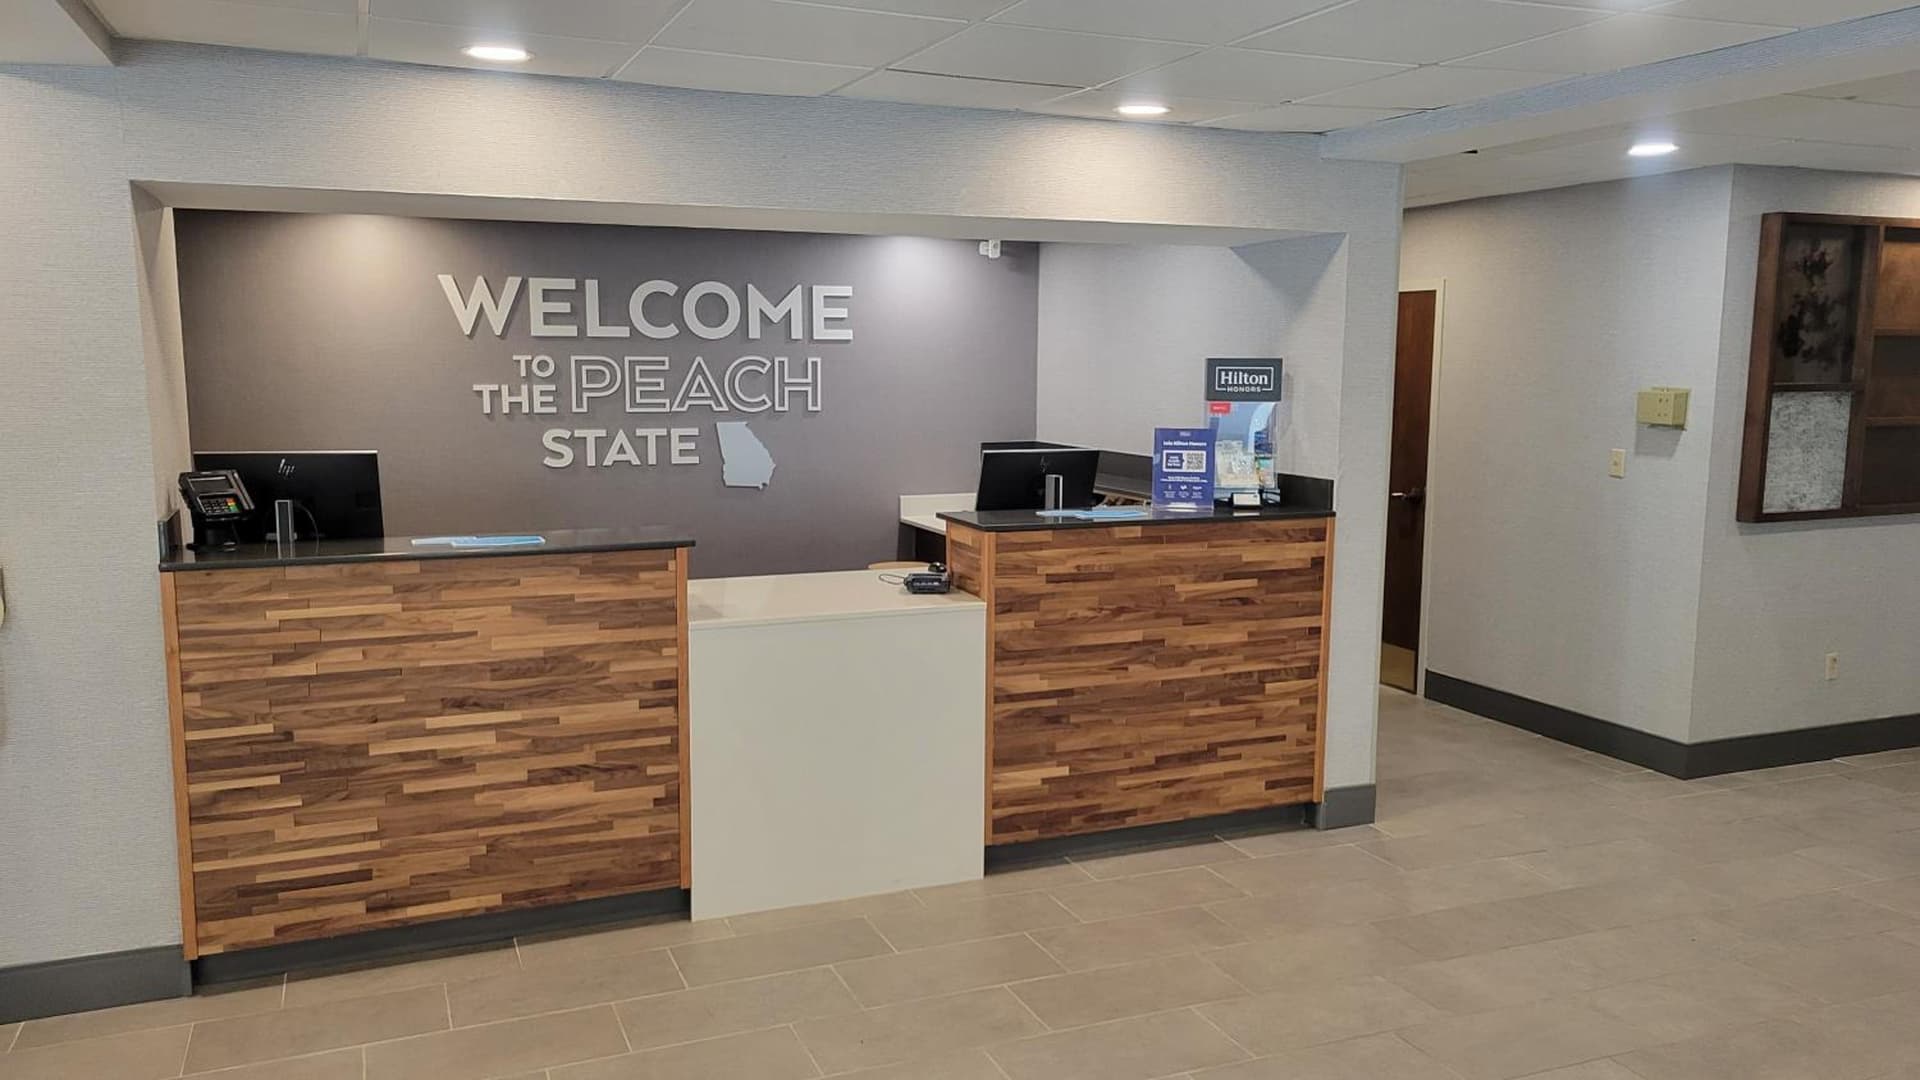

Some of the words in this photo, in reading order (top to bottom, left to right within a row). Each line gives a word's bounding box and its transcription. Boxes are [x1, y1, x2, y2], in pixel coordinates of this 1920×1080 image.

[437, 274, 853, 340] WELCOME
[473, 384, 557, 414] THE
[570, 355, 821, 412] PEACH
[512, 354, 556, 378] TO
[1221, 371, 1268, 385] Hilton
[542, 427, 699, 468] STATE
